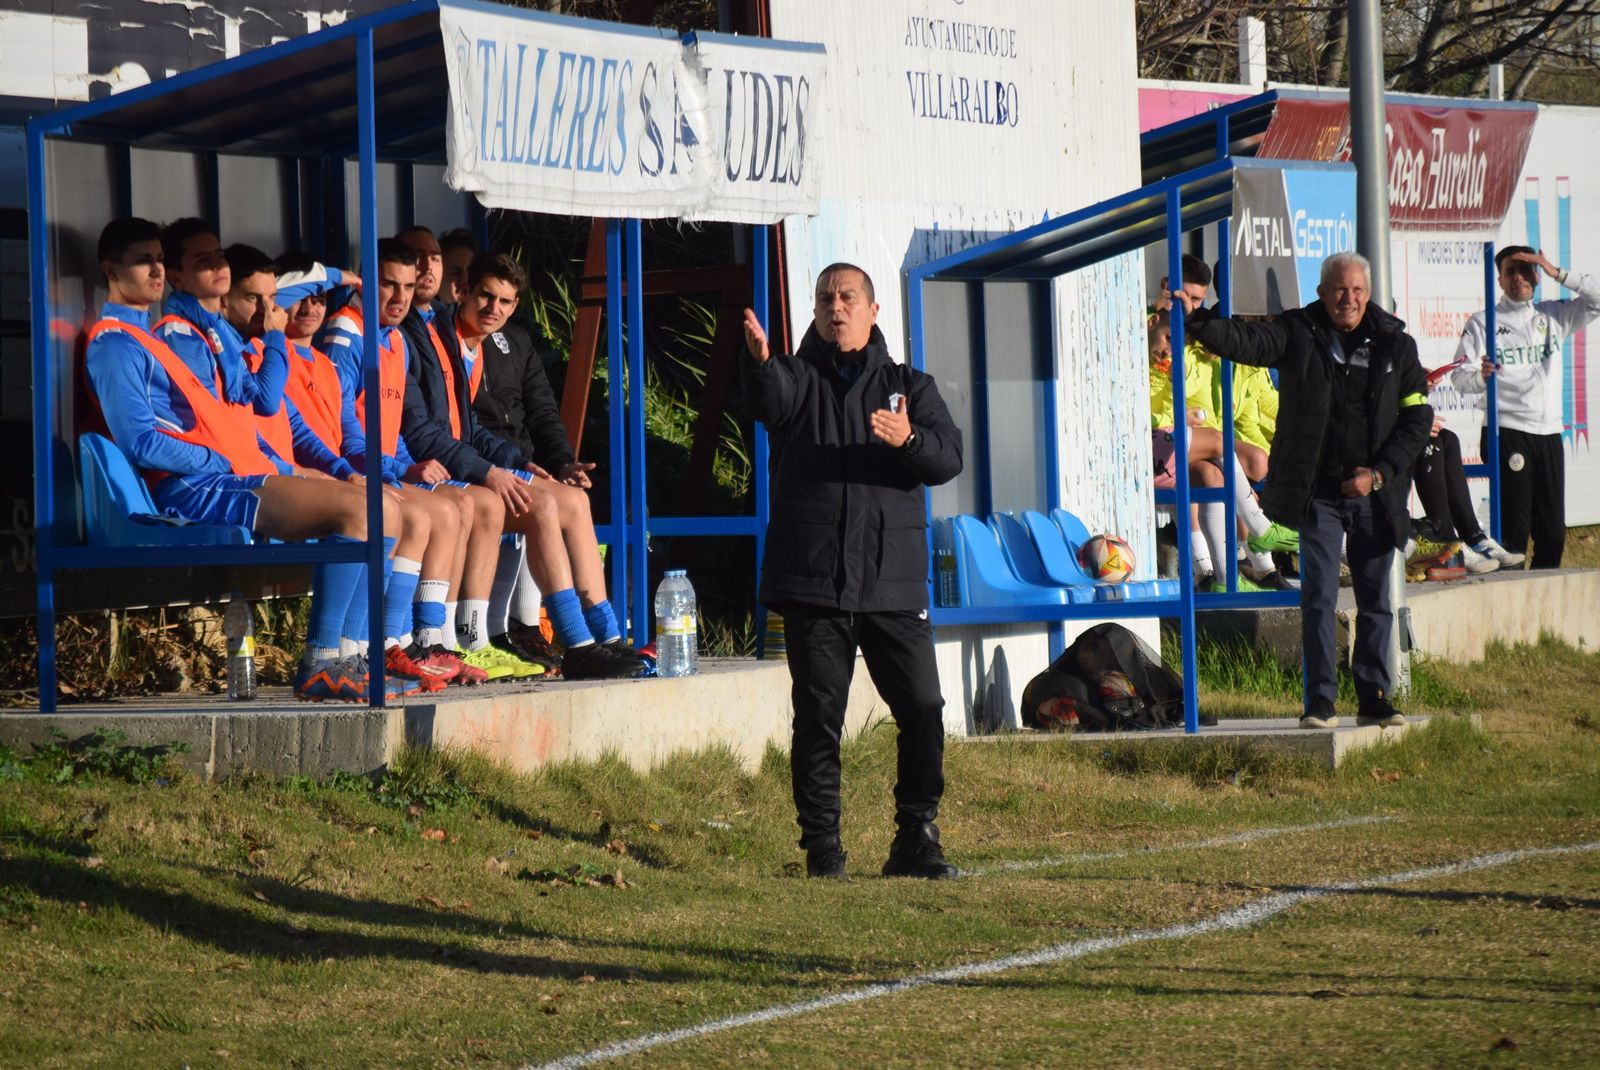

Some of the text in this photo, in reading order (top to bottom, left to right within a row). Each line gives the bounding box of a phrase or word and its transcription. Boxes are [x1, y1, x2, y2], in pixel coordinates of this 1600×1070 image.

[905, 16, 1017, 59] AYUNTAMIENTO DE
[476, 39, 810, 187] TALLERES SAUDES
[906, 70, 1019, 128] VILLARALBO
[1421, 127, 1488, 212] Aurelia
[1235, 207, 1292, 257] METAL
